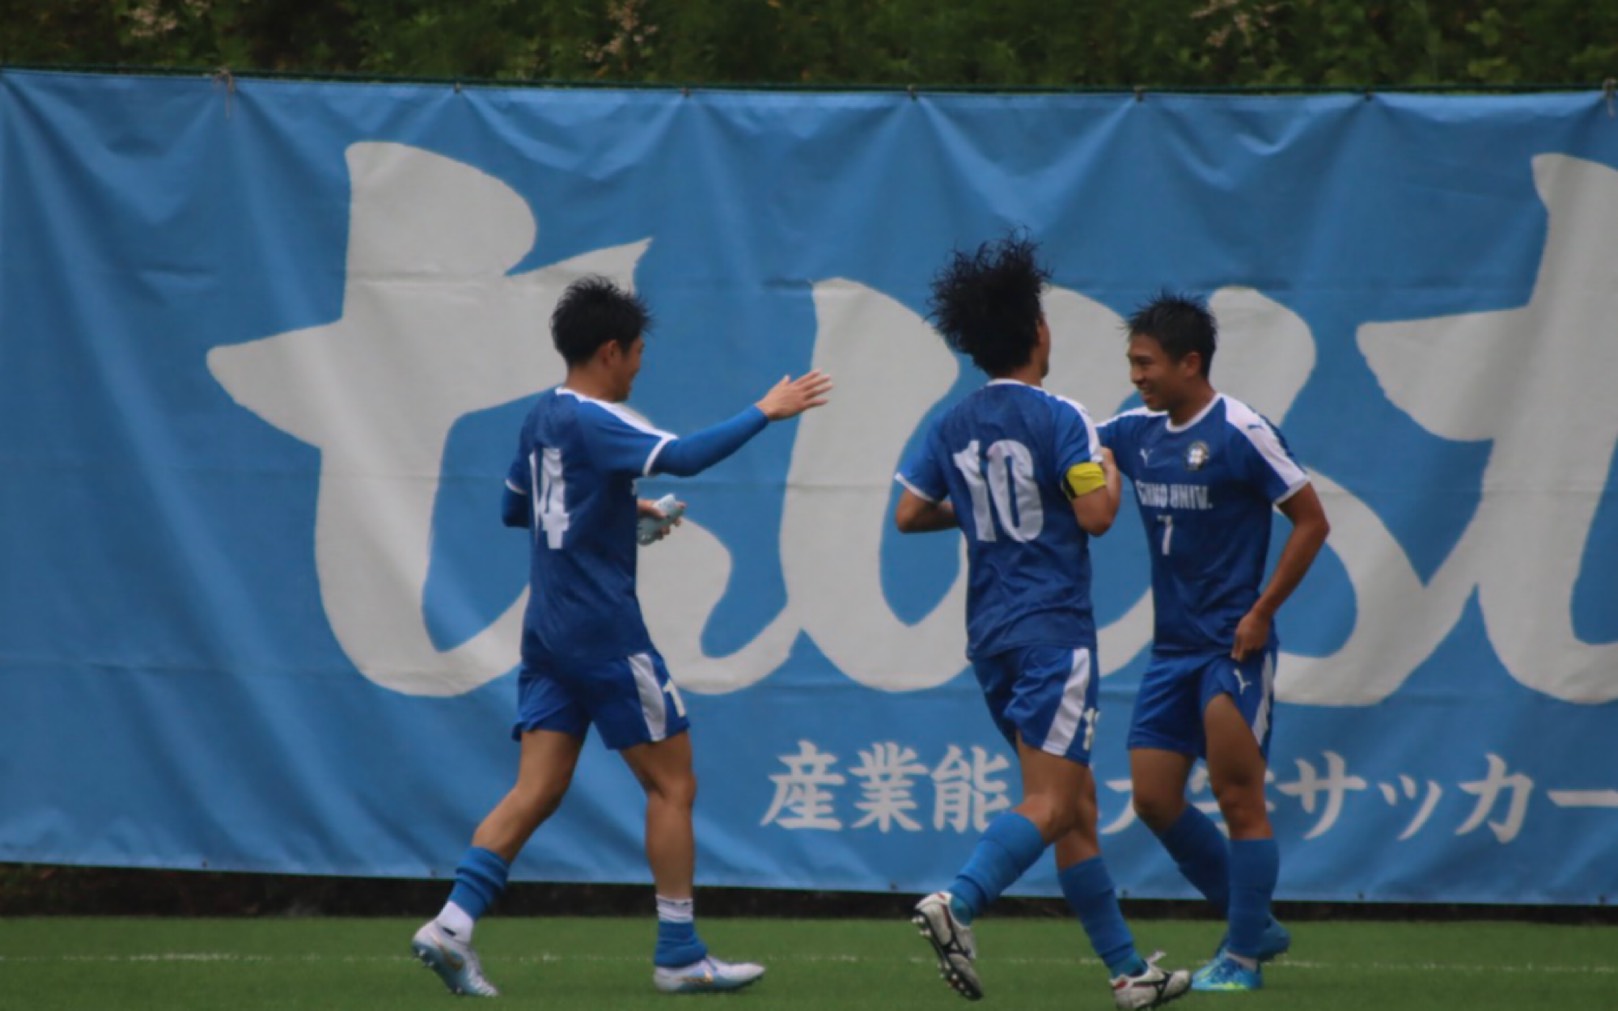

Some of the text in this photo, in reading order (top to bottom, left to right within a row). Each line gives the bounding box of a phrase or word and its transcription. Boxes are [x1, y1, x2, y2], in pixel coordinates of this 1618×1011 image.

[529, 448, 570, 549] 14
[953, 439, 1043, 543] 10
[1157, 515, 1173, 555] 7
[761, 740, 1618, 843] 産業能サッカー
